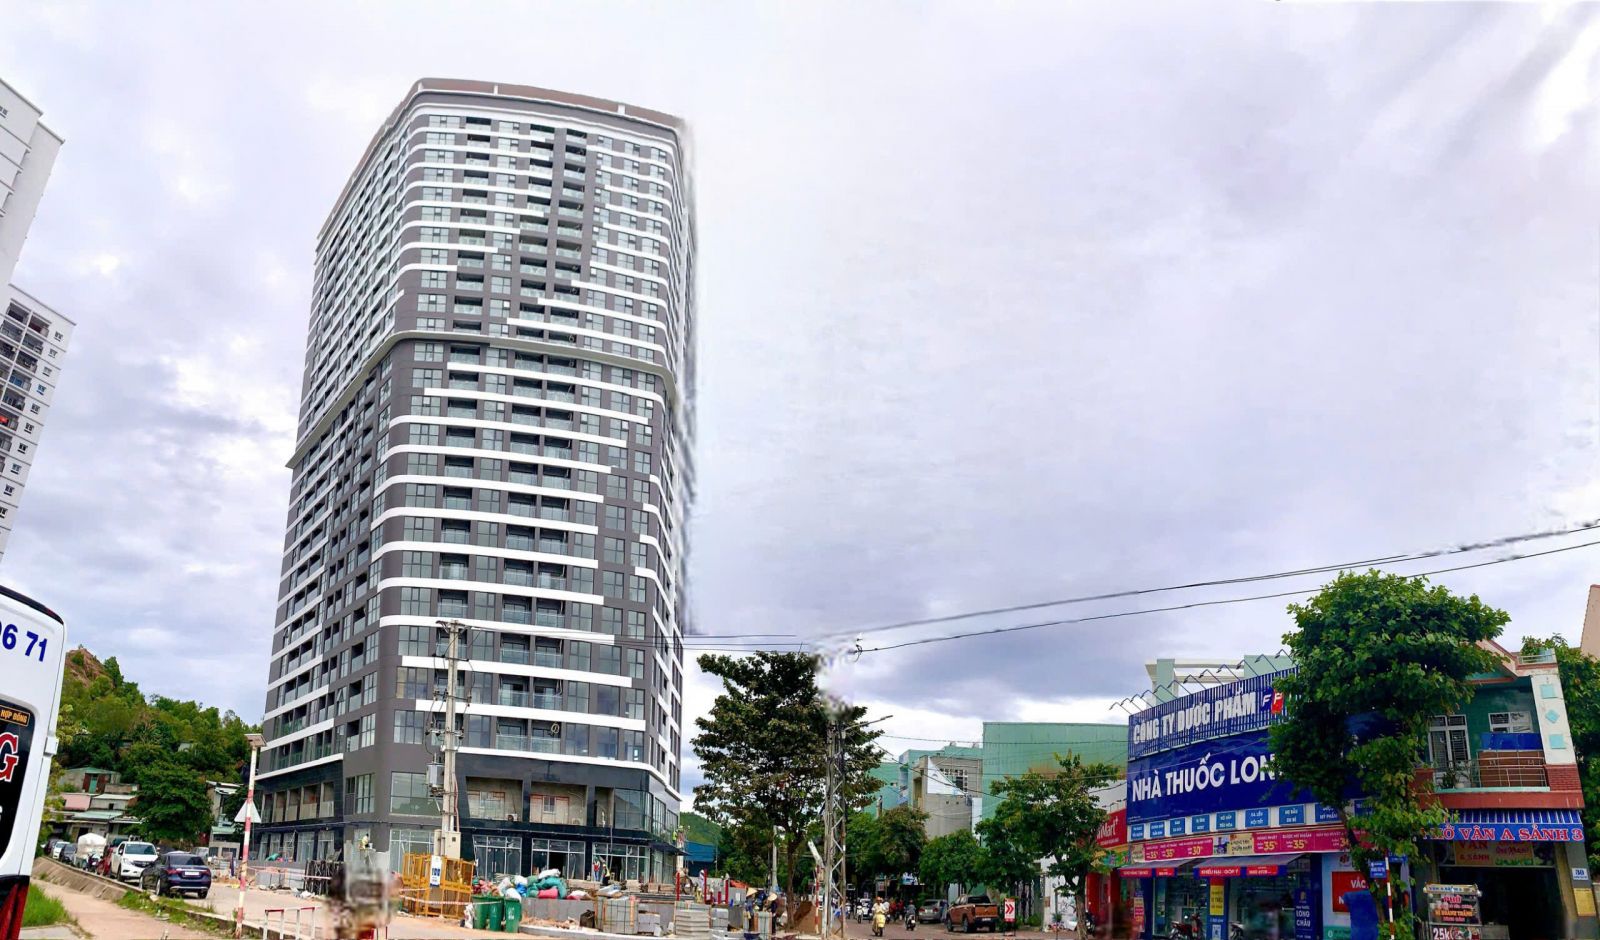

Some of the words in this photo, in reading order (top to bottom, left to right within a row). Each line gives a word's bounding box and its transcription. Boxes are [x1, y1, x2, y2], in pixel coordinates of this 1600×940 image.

[25, 630, 48, 662] 71
[0, 709, 12, 720] HỢP
[12, 712, 28, 723] ĐỒNG
[1133, 717, 1160, 745] CÔNG
[1161, 713, 1176, 736] TY
[1214, 684, 1257, 722] PHẨM
[1132, 769, 1162, 802] NHÀ
[1165, 752, 1226, 795] THUỐC
[1230, 753, 1284, 785] LON
[1458, 825, 1496, 840] VÂN
[1501, 828, 1515, 840] A
[1518, 823, 1570, 840] SẢNH
[1571, 828, 1584, 840] 3
